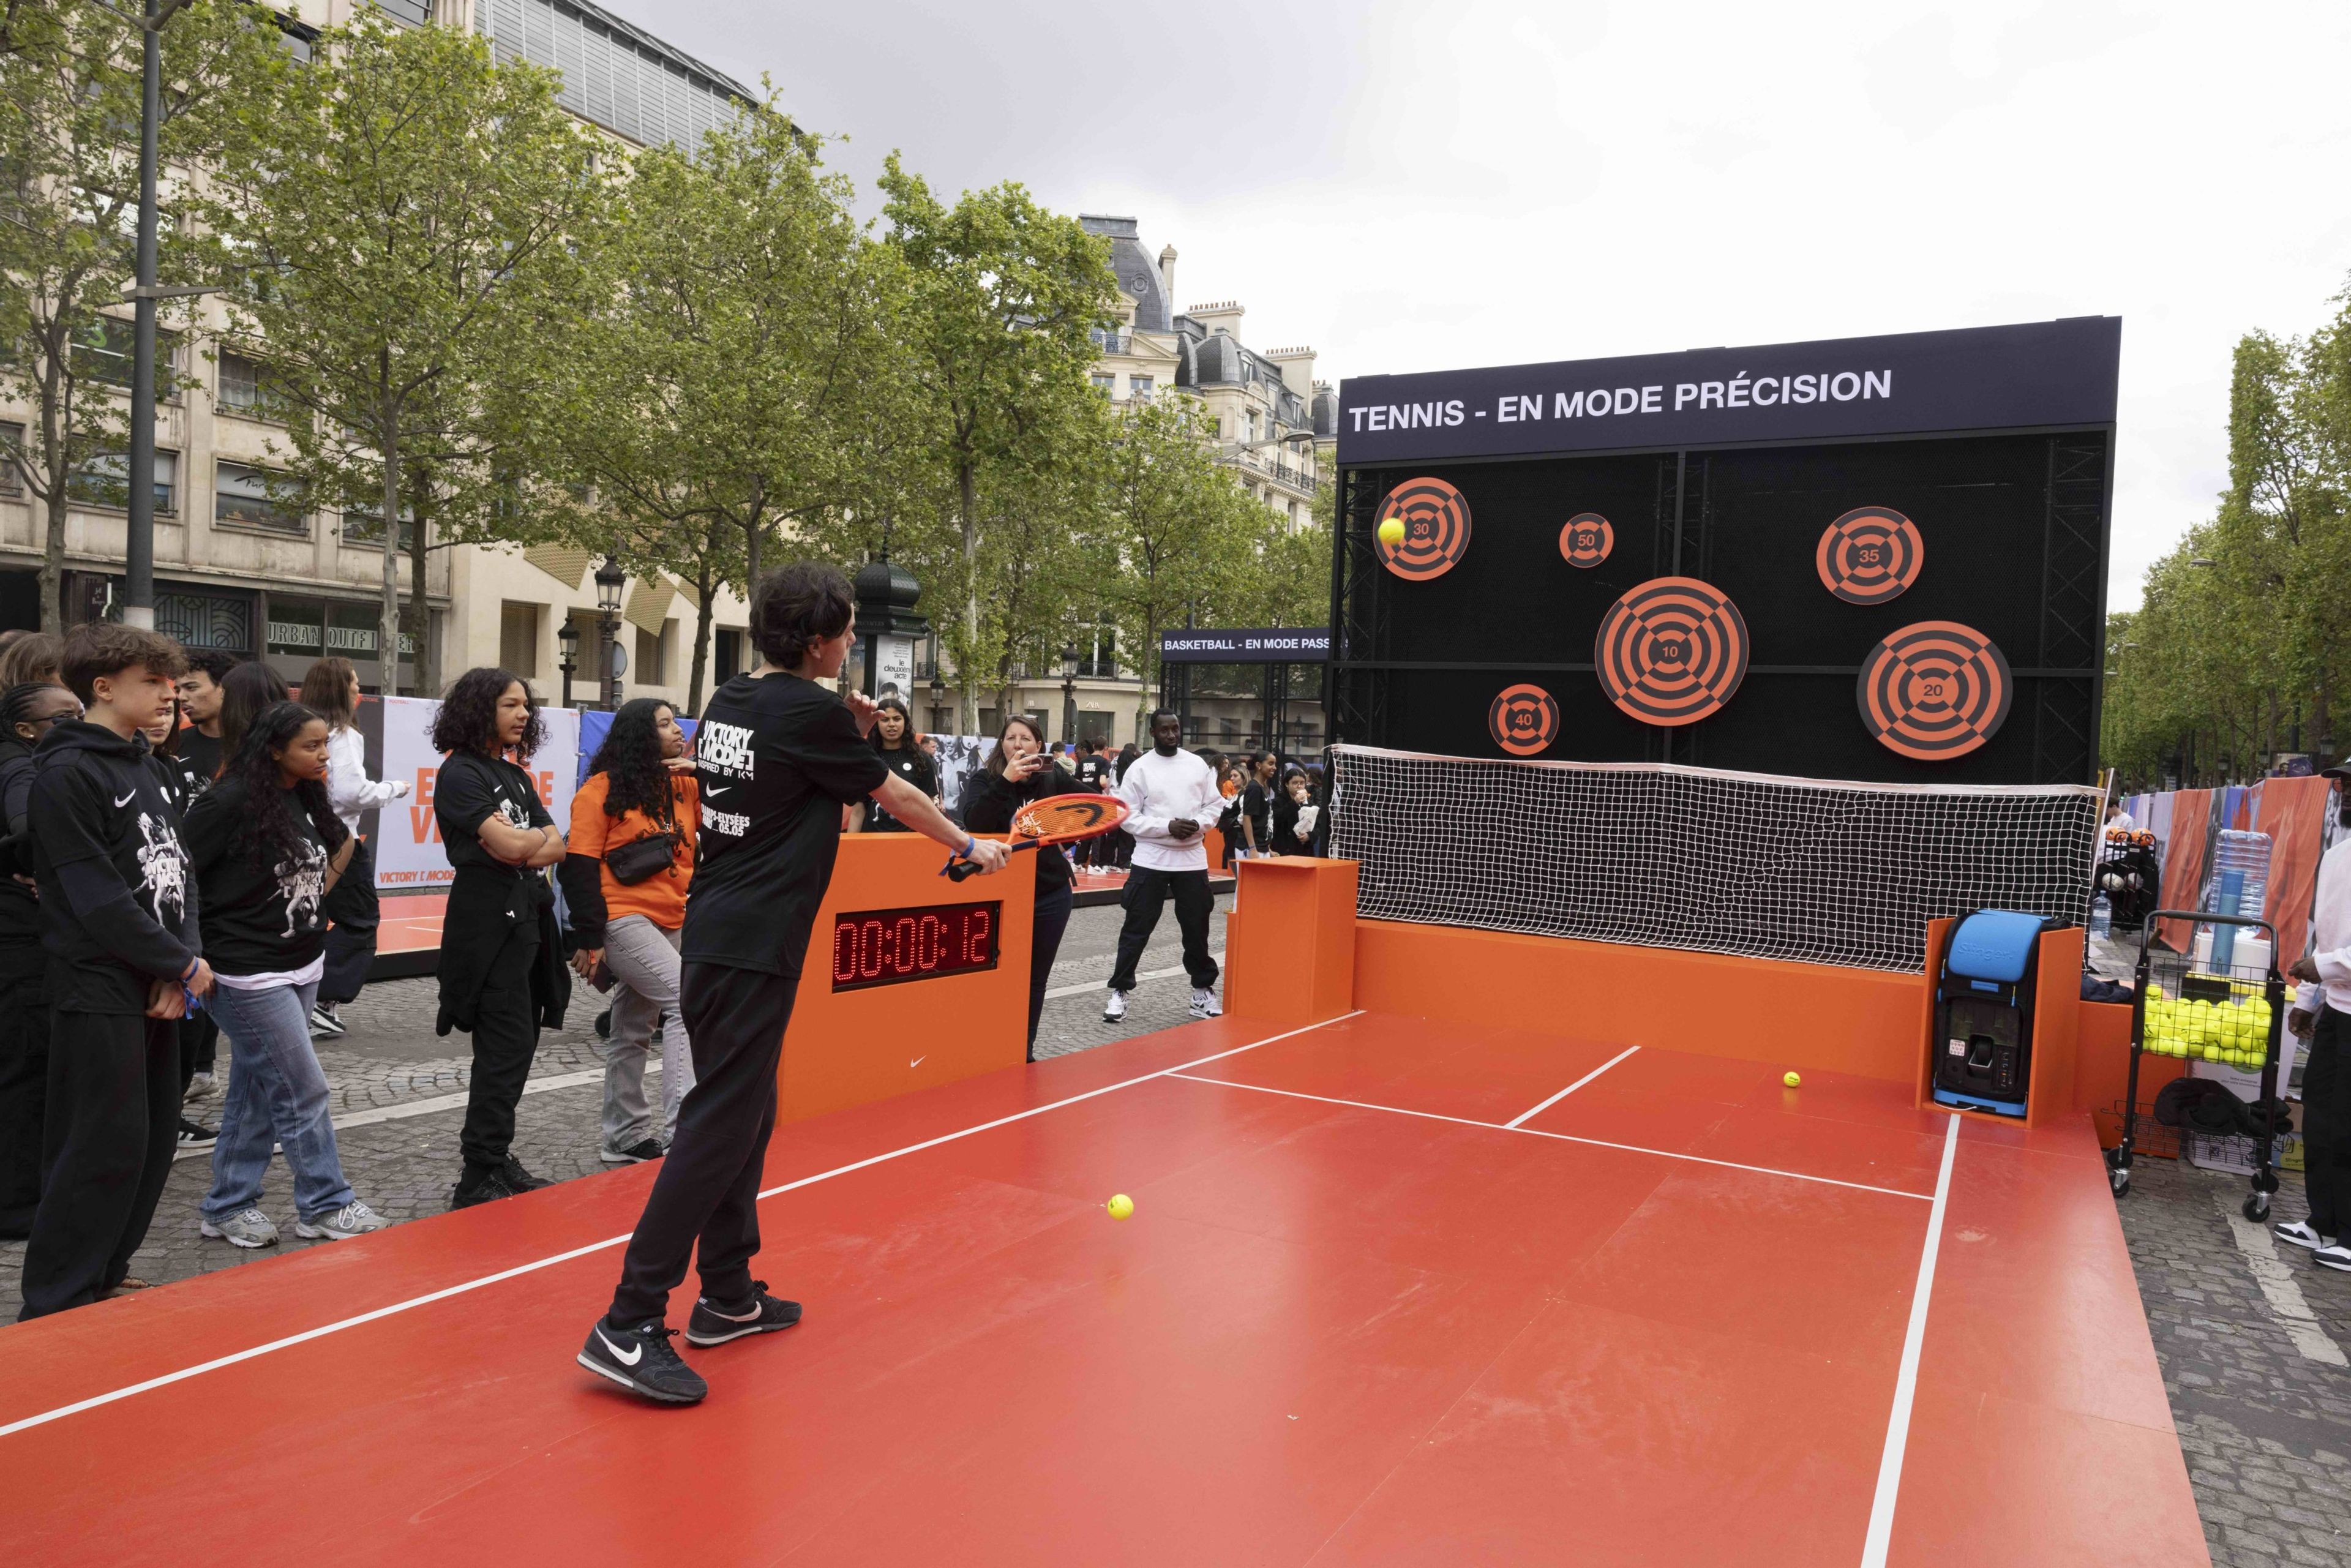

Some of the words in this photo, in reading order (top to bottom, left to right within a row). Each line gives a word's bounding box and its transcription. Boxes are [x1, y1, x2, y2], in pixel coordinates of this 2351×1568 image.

[1349, 400, 1465, 432] TENNIS
[1498, 394, 1542, 422] EN
[1554, 385, 1663, 419] MODE
[1674, 370, 1892, 411] PRÉCISION
[1413, 523, 1430, 535] 30
[1577, 534, 1595, 547] 50
[1859, 549, 1880, 563] 35
[268, 622, 321, 646] URBAN
[1164, 640, 1235, 650] BASKETBALL
[1245, 639, 1261, 649] EN
[1264, 639, 1298, 649] MODE
[1662, 646, 1679, 658] 10
[1923, 684, 1943, 697] 20
[1515, 713, 1533, 726] 40
[703, 719, 754, 749] VICTORY
[723, 767, 734, 777] BY
[380, 871, 418, 883] VICTORY
